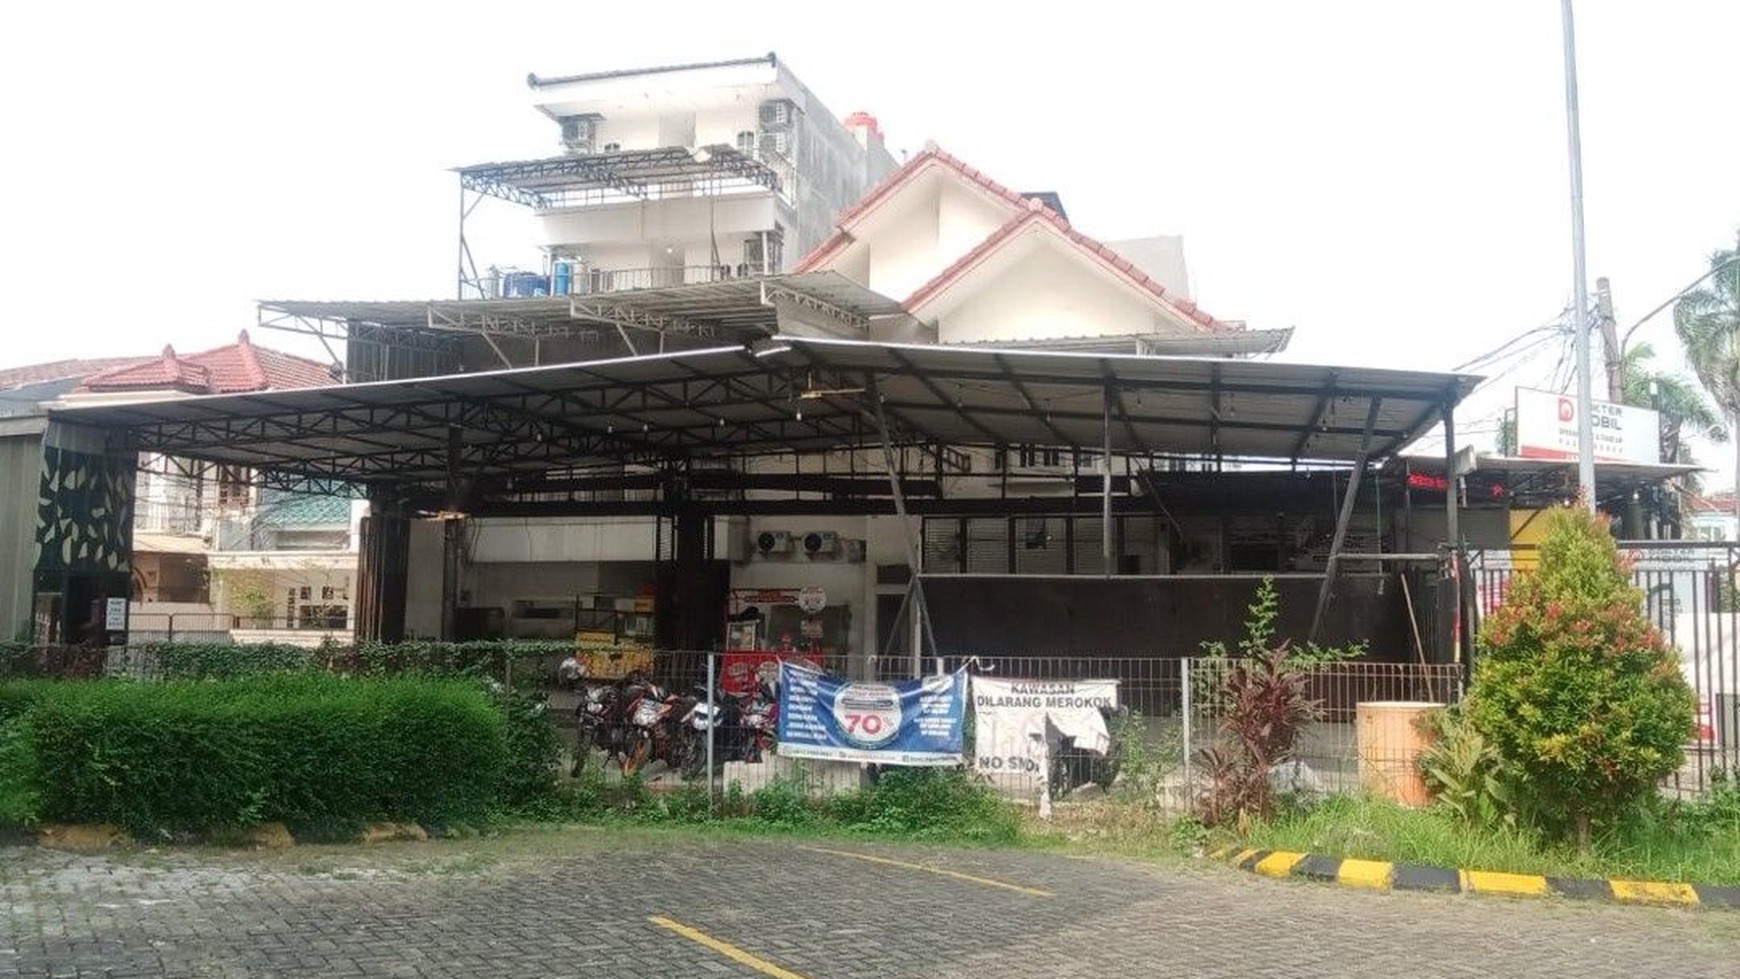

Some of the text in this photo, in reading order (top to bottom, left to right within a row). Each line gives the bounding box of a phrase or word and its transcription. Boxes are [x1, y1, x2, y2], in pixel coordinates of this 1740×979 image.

[1590, 414, 1622, 431] OBIL
[1011, 682, 1074, 694] KAWASAN
[977, 695, 1110, 708] DILARANG MEROKOK
[979, 757, 1002, 769] NO
